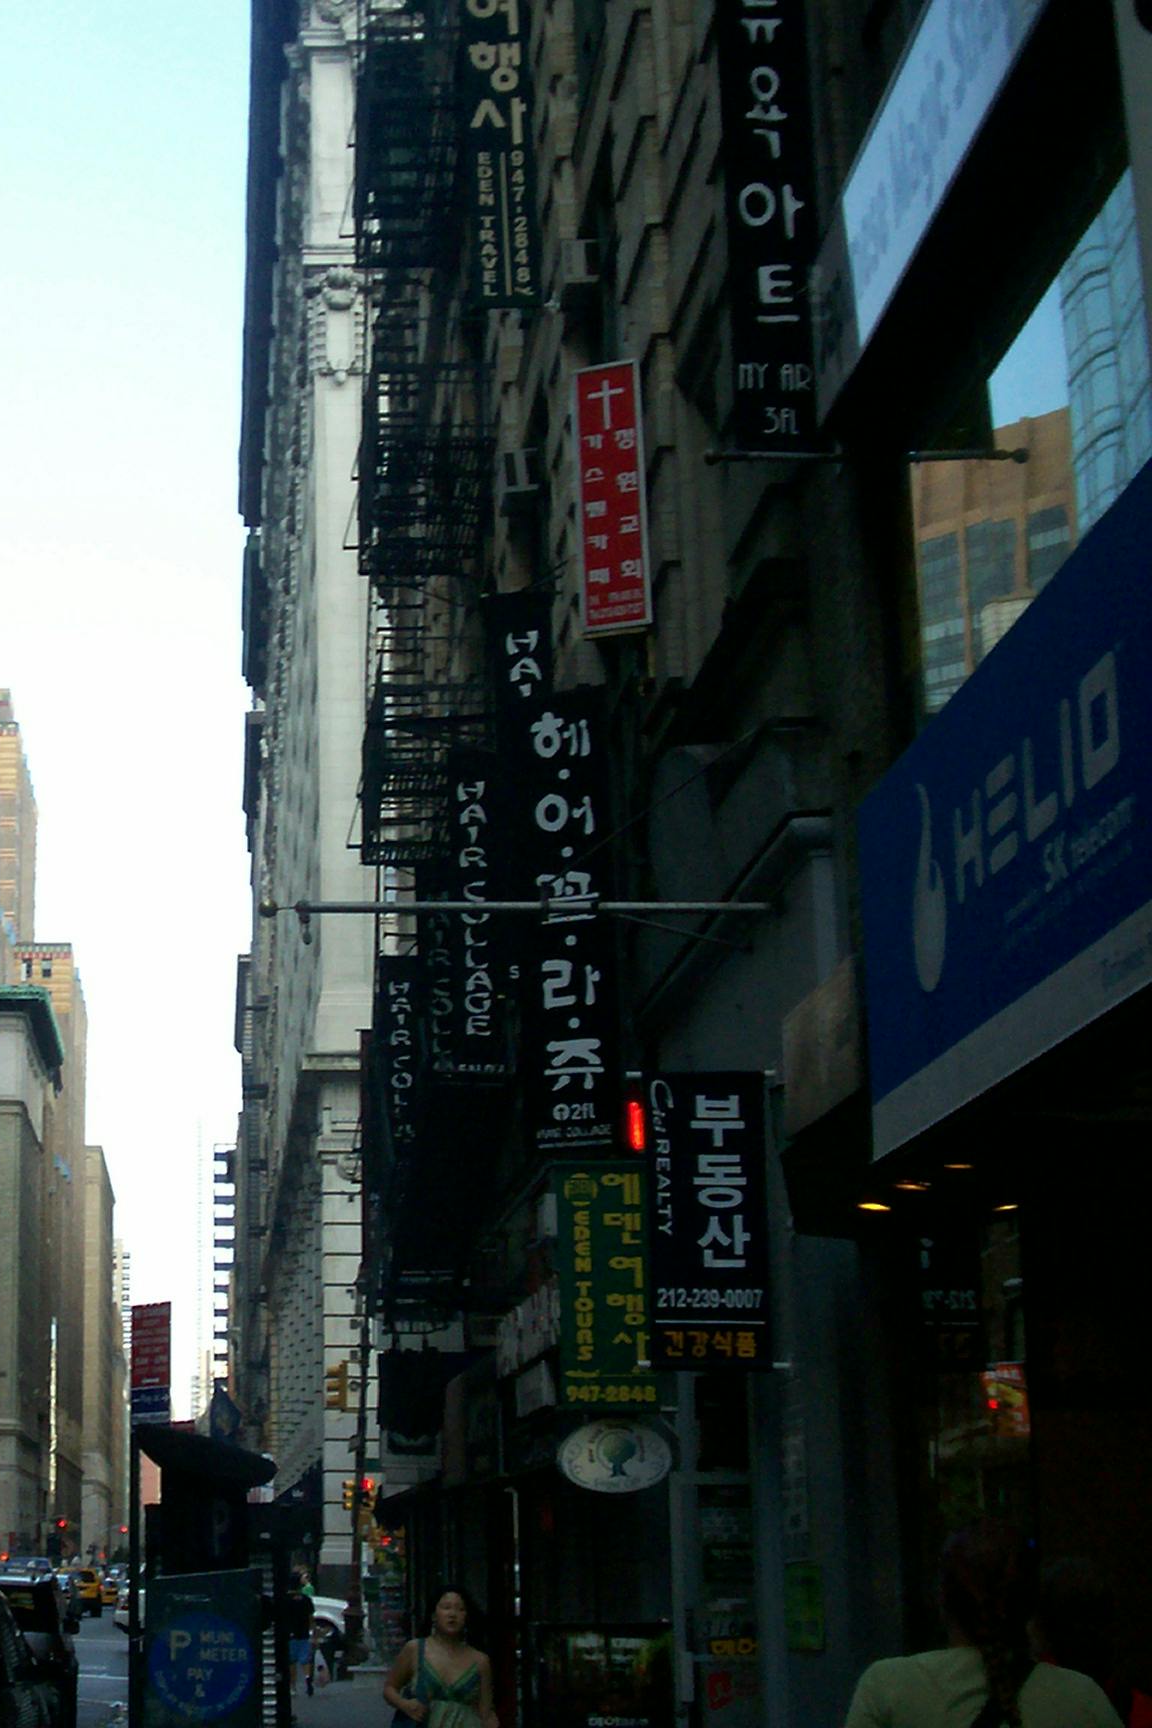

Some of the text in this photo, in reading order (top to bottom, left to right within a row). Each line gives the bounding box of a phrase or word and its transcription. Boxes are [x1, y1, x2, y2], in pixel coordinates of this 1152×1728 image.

[477, 152, 498, 297] EDEN TRAVEL
[953, 650, 1121, 904] HELIO
[456, 780, 488, 868] HAIR
[655, 1139, 673, 1237] REALTY
[690, 1094, 752, 1268] 부동산
[573, 1210, 593, 1273] EDEN
[574, 1281, 595, 1361] TOURS
[656, 1289, 765, 1309] 212-239-0007
[663, 1331, 758, 1360] 건강식품
[199, 1647, 248, 1662] METER
